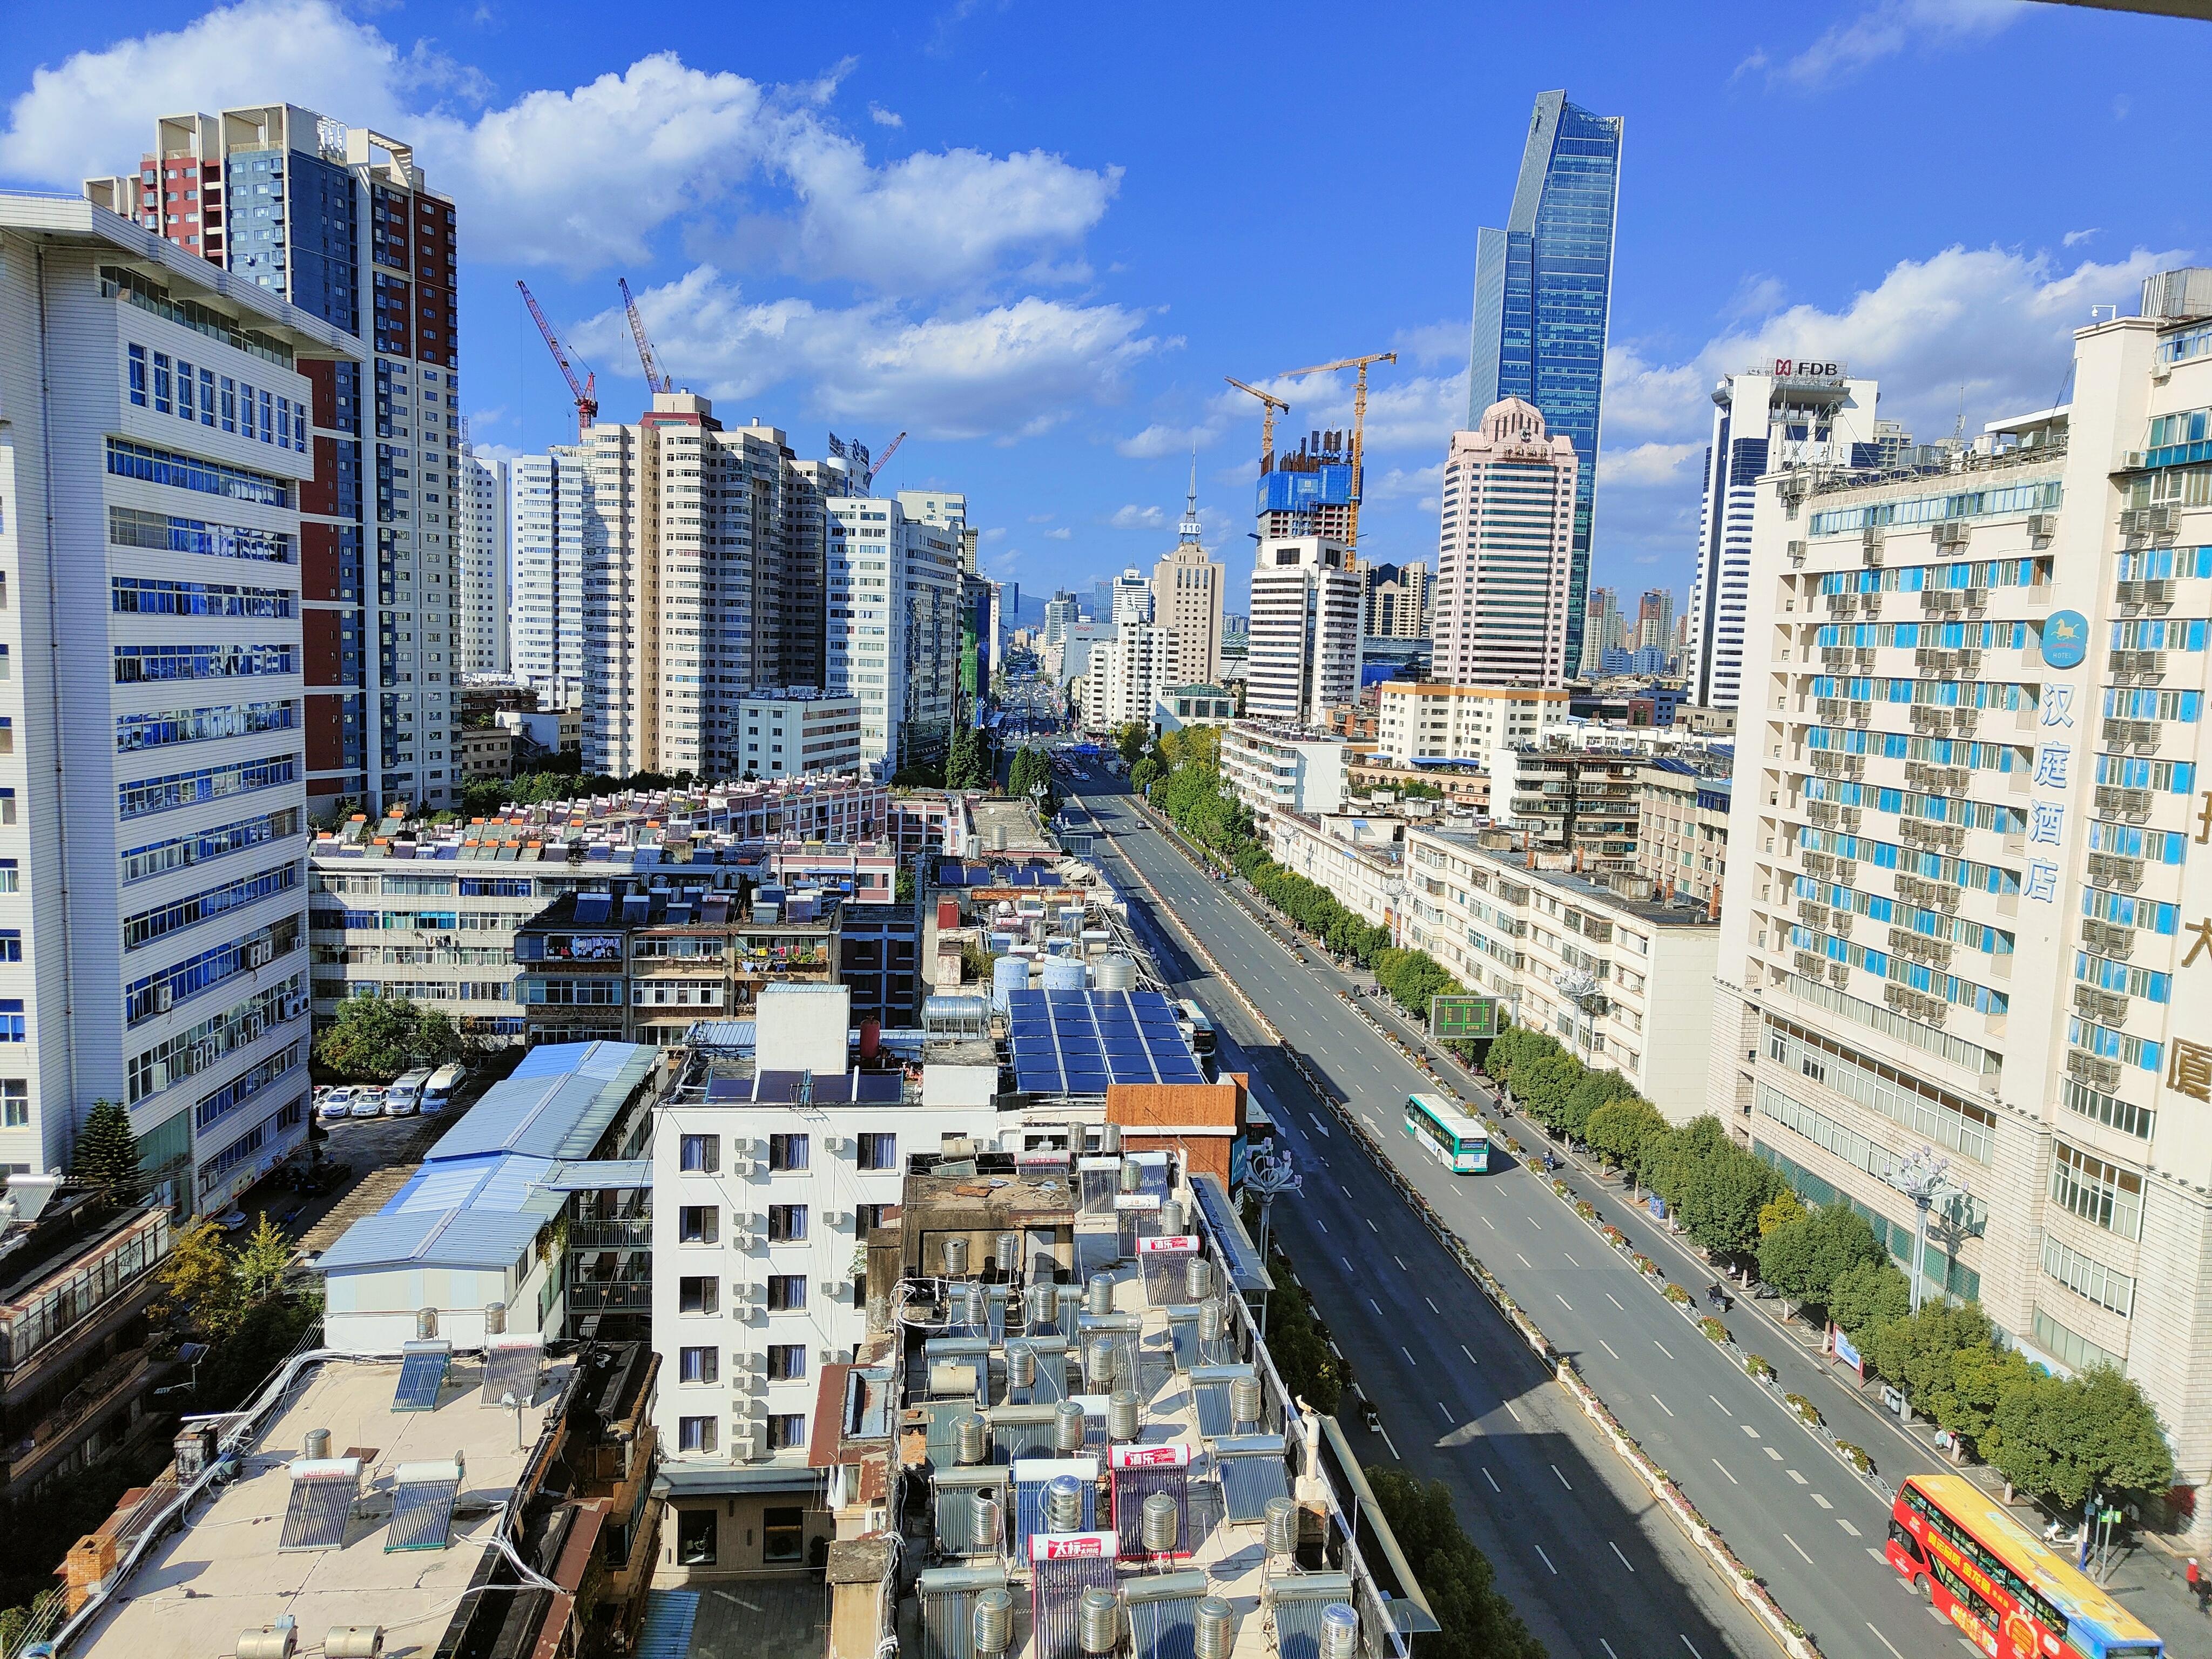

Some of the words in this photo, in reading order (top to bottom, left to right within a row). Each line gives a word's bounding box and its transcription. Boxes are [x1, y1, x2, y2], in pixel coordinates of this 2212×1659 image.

[1798, 362, 1838, 376] FDB
[2024, 683, 2074, 904] 汉庭酒店
[1130, 1453, 1155, 1465] 滇乐
[1053, 1542, 1081, 1558] 太标
[1962, 1561, 1991, 1595] 金龙鱼
